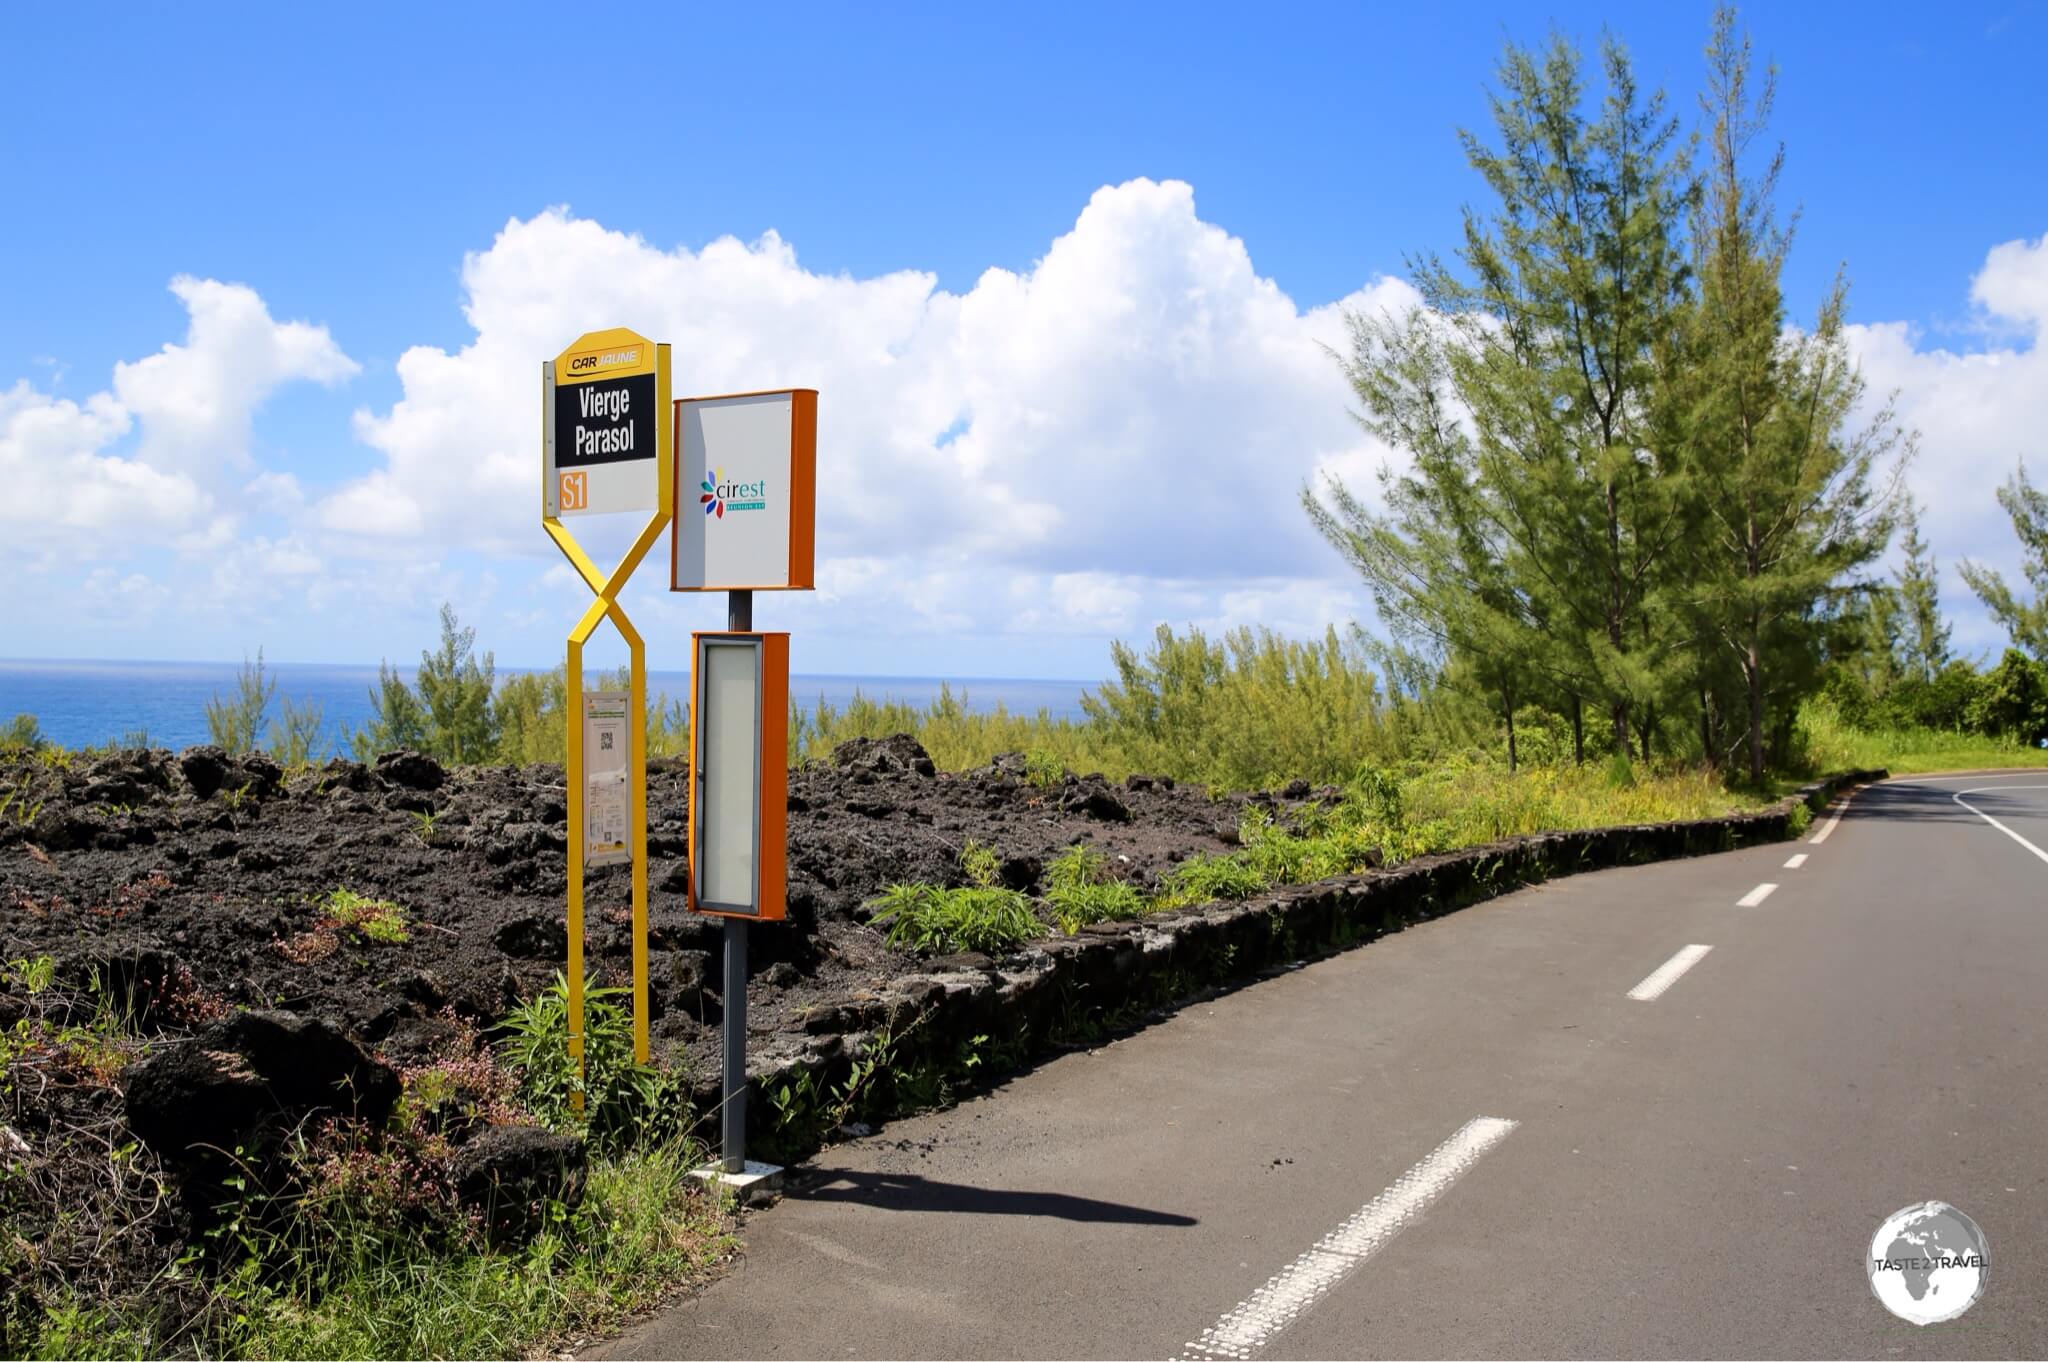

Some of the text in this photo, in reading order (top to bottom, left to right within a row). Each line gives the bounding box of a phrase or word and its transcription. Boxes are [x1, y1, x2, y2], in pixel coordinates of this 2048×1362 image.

[571, 356, 597, 370] CAR
[579, 386, 630, 422] Vierge
[575, 419, 634, 456] Parasol
[562, 474, 584, 508] S1
[716, 480, 765, 499] cirest
